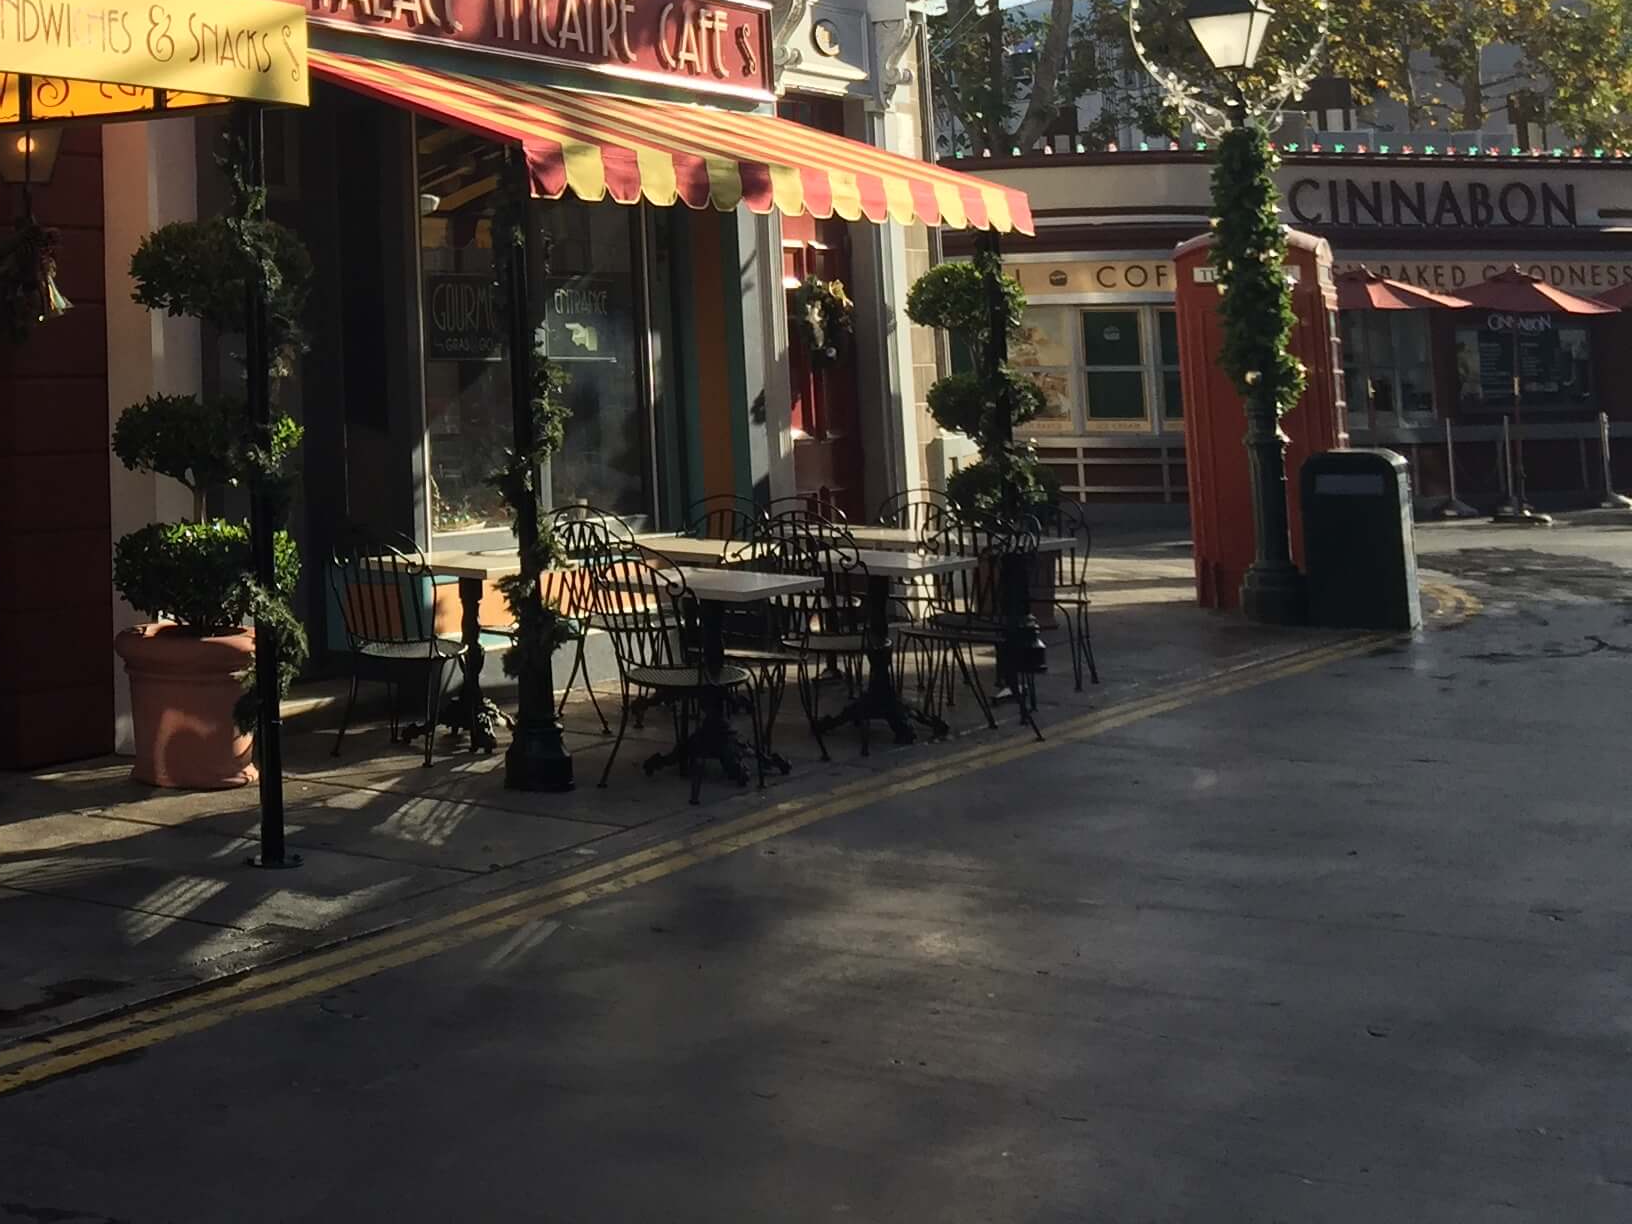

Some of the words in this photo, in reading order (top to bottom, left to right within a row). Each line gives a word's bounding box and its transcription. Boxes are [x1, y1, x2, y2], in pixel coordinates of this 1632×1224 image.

[146, 4, 175, 62] &
[189, 12, 273, 74] SNACKS
[1287, 178, 1577, 226] CINNABON
[554, 288, 608, 315] ENTRANCE
